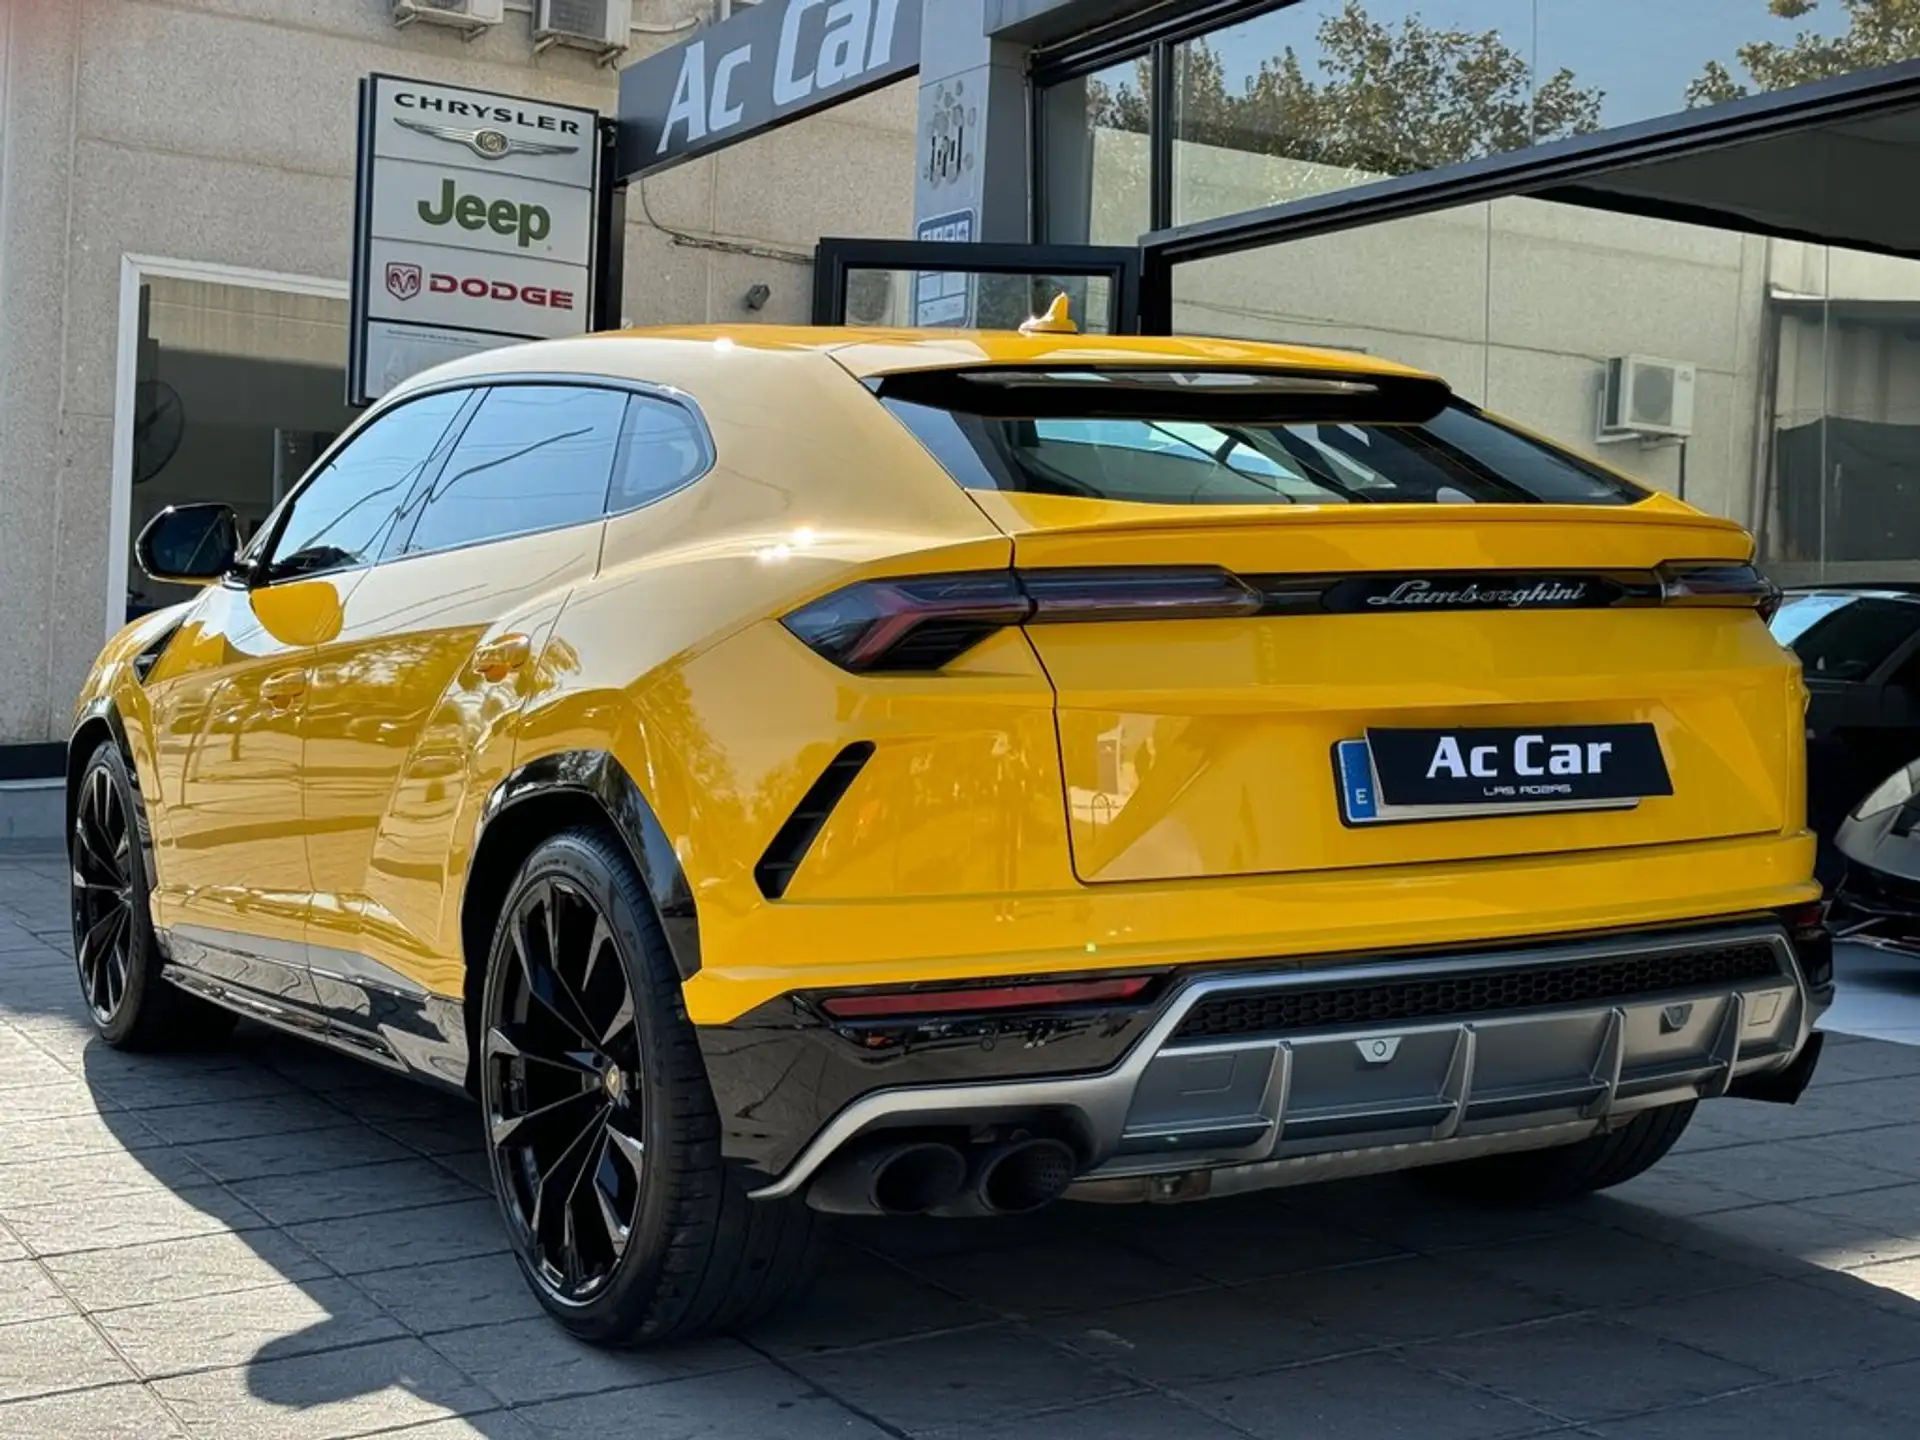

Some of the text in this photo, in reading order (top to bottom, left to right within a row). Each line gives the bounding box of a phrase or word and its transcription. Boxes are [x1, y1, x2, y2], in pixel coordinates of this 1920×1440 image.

[656, 0, 899, 155] Ac Car
[394, 93, 580, 136] CHRYSLER
[417, 178, 551, 248] Jeep
[429, 273, 574, 310] DODGE
[1366, 579, 1587, 606] Lamborghini
[1426, 734, 1612, 777] Ac Car
[1355, 788, 1368, 804] E
[1483, 785, 1516, 797] LAS
